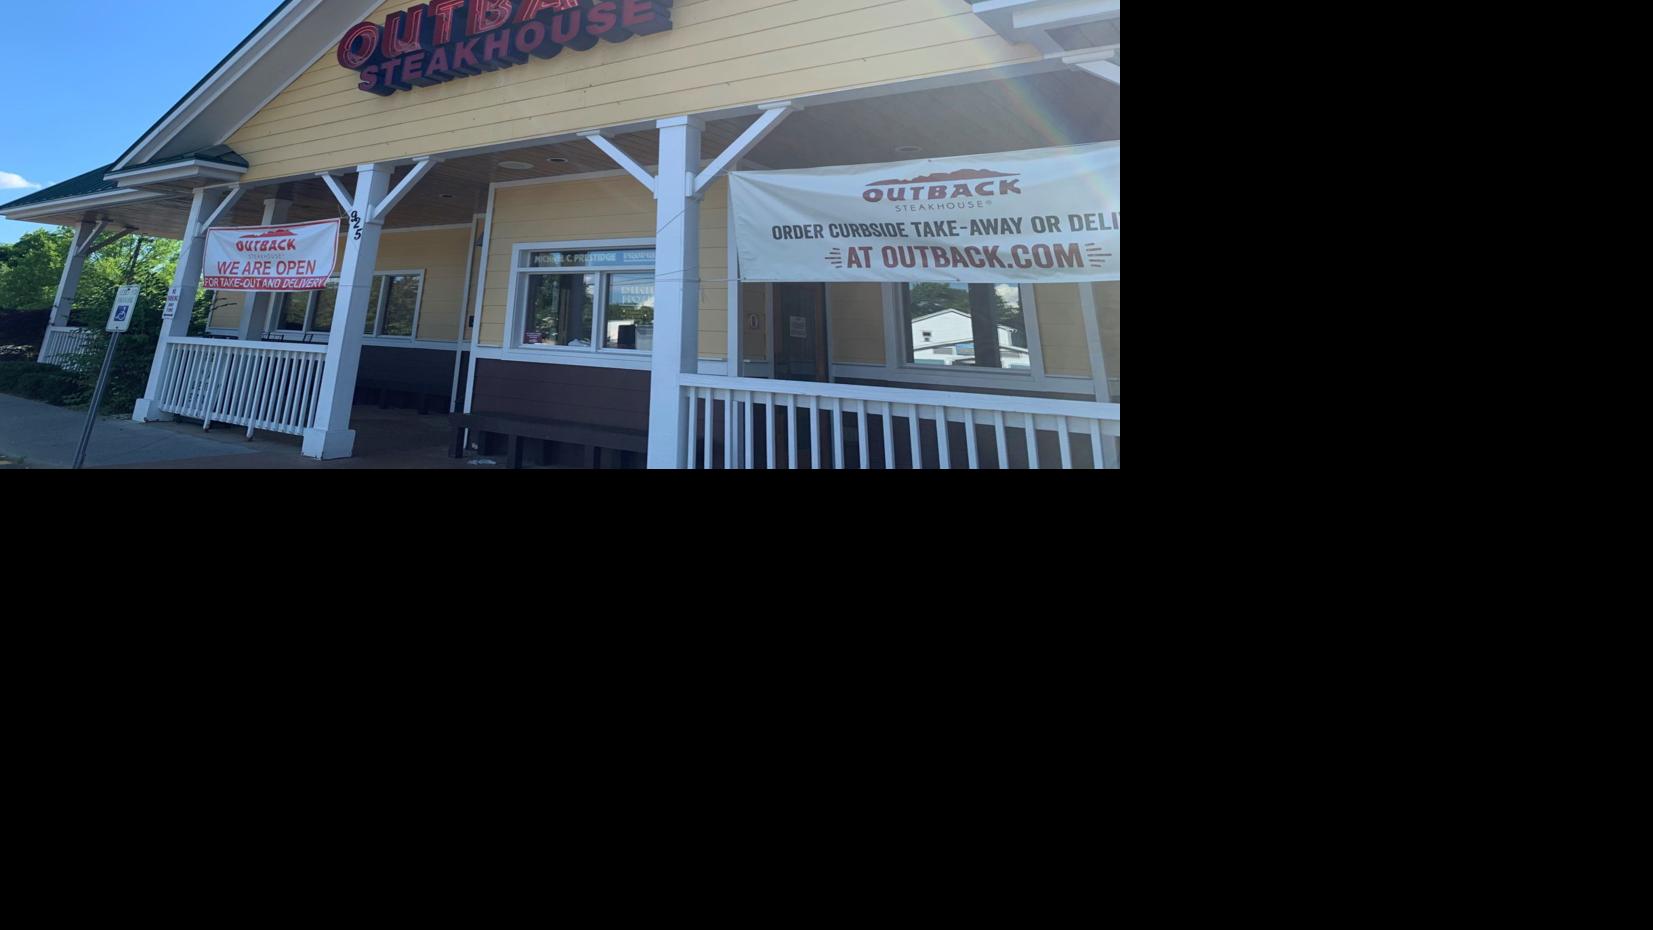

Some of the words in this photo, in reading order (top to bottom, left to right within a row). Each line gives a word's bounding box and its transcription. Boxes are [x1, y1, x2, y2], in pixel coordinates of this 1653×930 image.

[359, 0, 659, 92] STEAKHOUSE
[863, 178, 1022, 203] OUTBACK
[771, 223, 825, 241] ORDER
[828, 221, 909, 239] CURBSIDE
[911, 216, 1023, 238] TAKE-AWAY
[1031, 213, 1062, 234] OR
[1067, 210, 1120, 232] DELI
[236, 238, 296, 252] OUTBACK
[847, 245, 874, 269] AT
[881, 242, 1085, 269] OUTBACK.COM
[217, 261, 240, 275] WE
[242, 260, 271, 275] ARE
[276, 260, 317, 275] OPEN
[204, 277, 219, 287] FOR
[220, 278, 261, 288] TAKE-OUT
[262, 278, 280, 289] AND
[281, 277, 325, 289] DELIVERY
